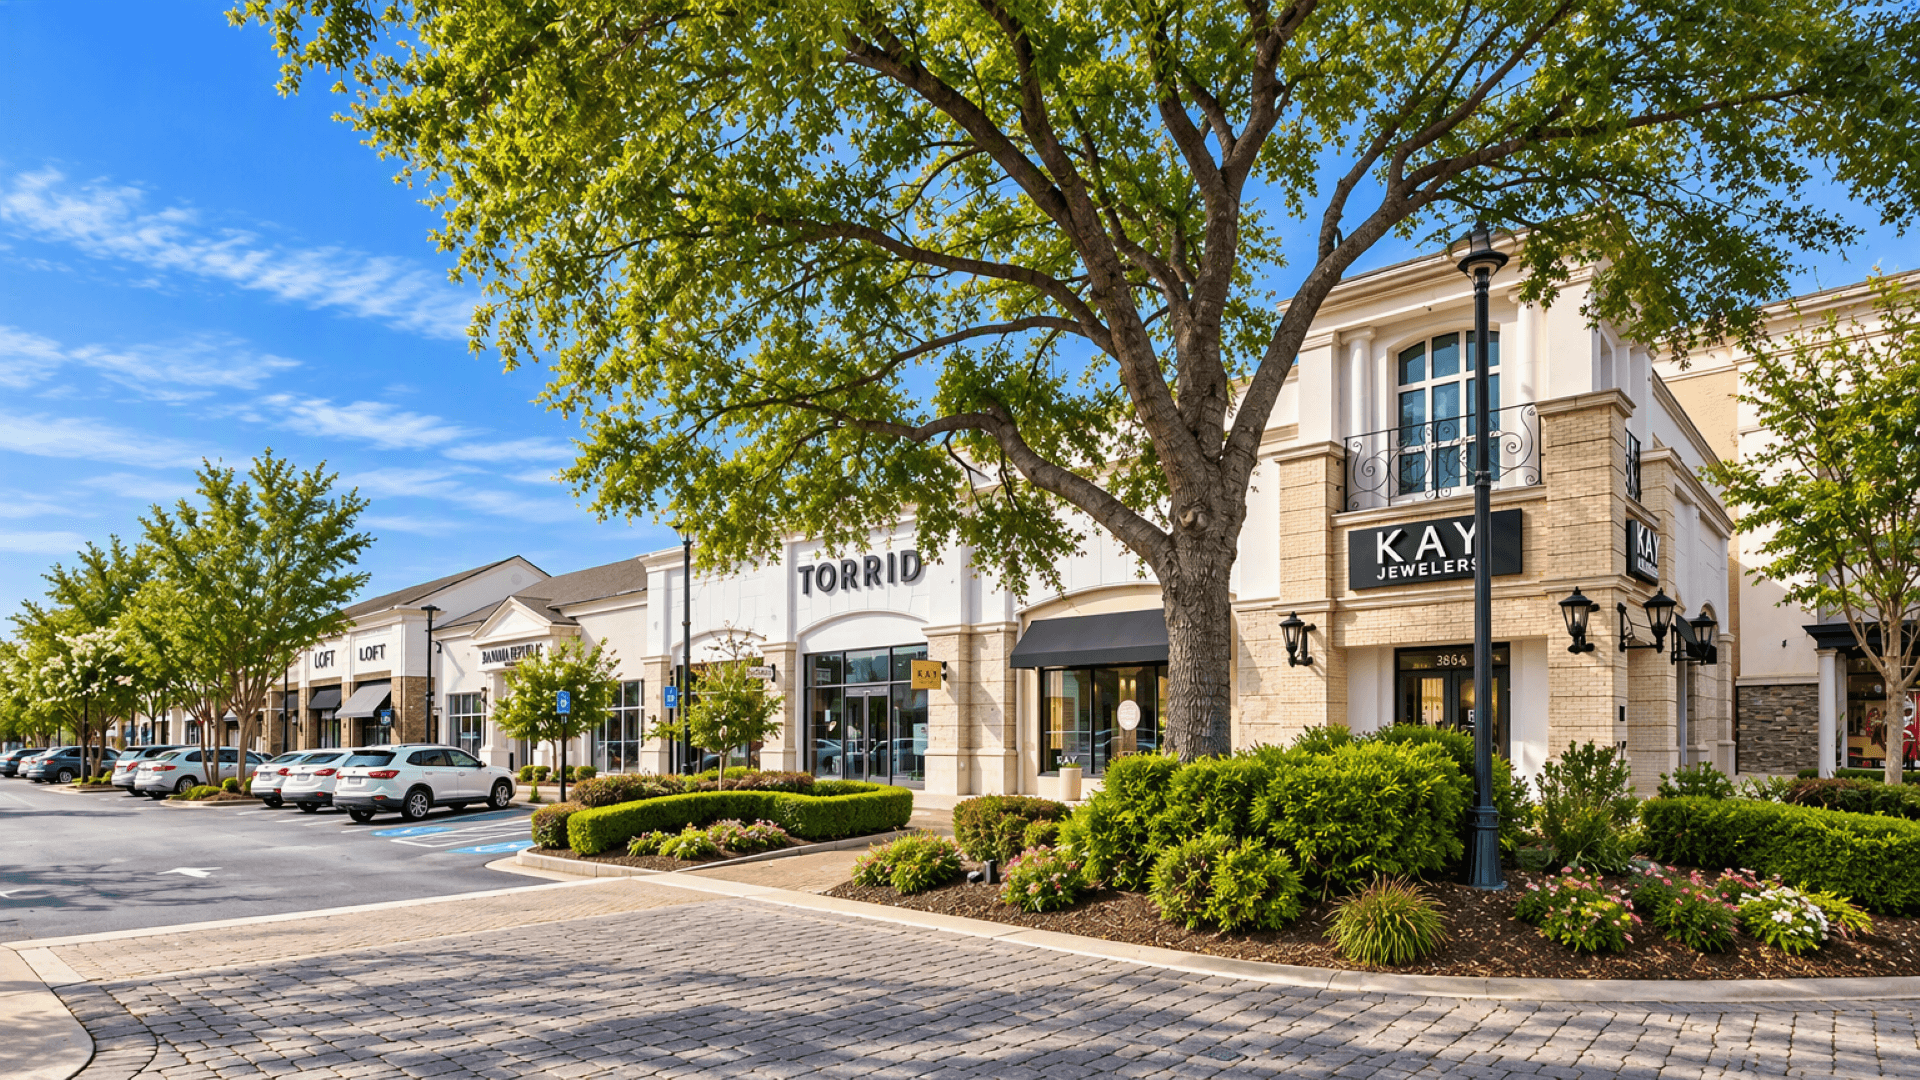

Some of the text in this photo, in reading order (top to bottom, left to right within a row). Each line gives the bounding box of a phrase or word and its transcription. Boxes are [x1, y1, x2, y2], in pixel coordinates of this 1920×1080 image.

[1376, 521, 1476, 565] KAY
[1636, 520, 1661, 565] KAY
[797, 549, 921, 595] TORRID
[314, 650, 336, 669] LOFT
[359, 643, 387, 662] LOFT
